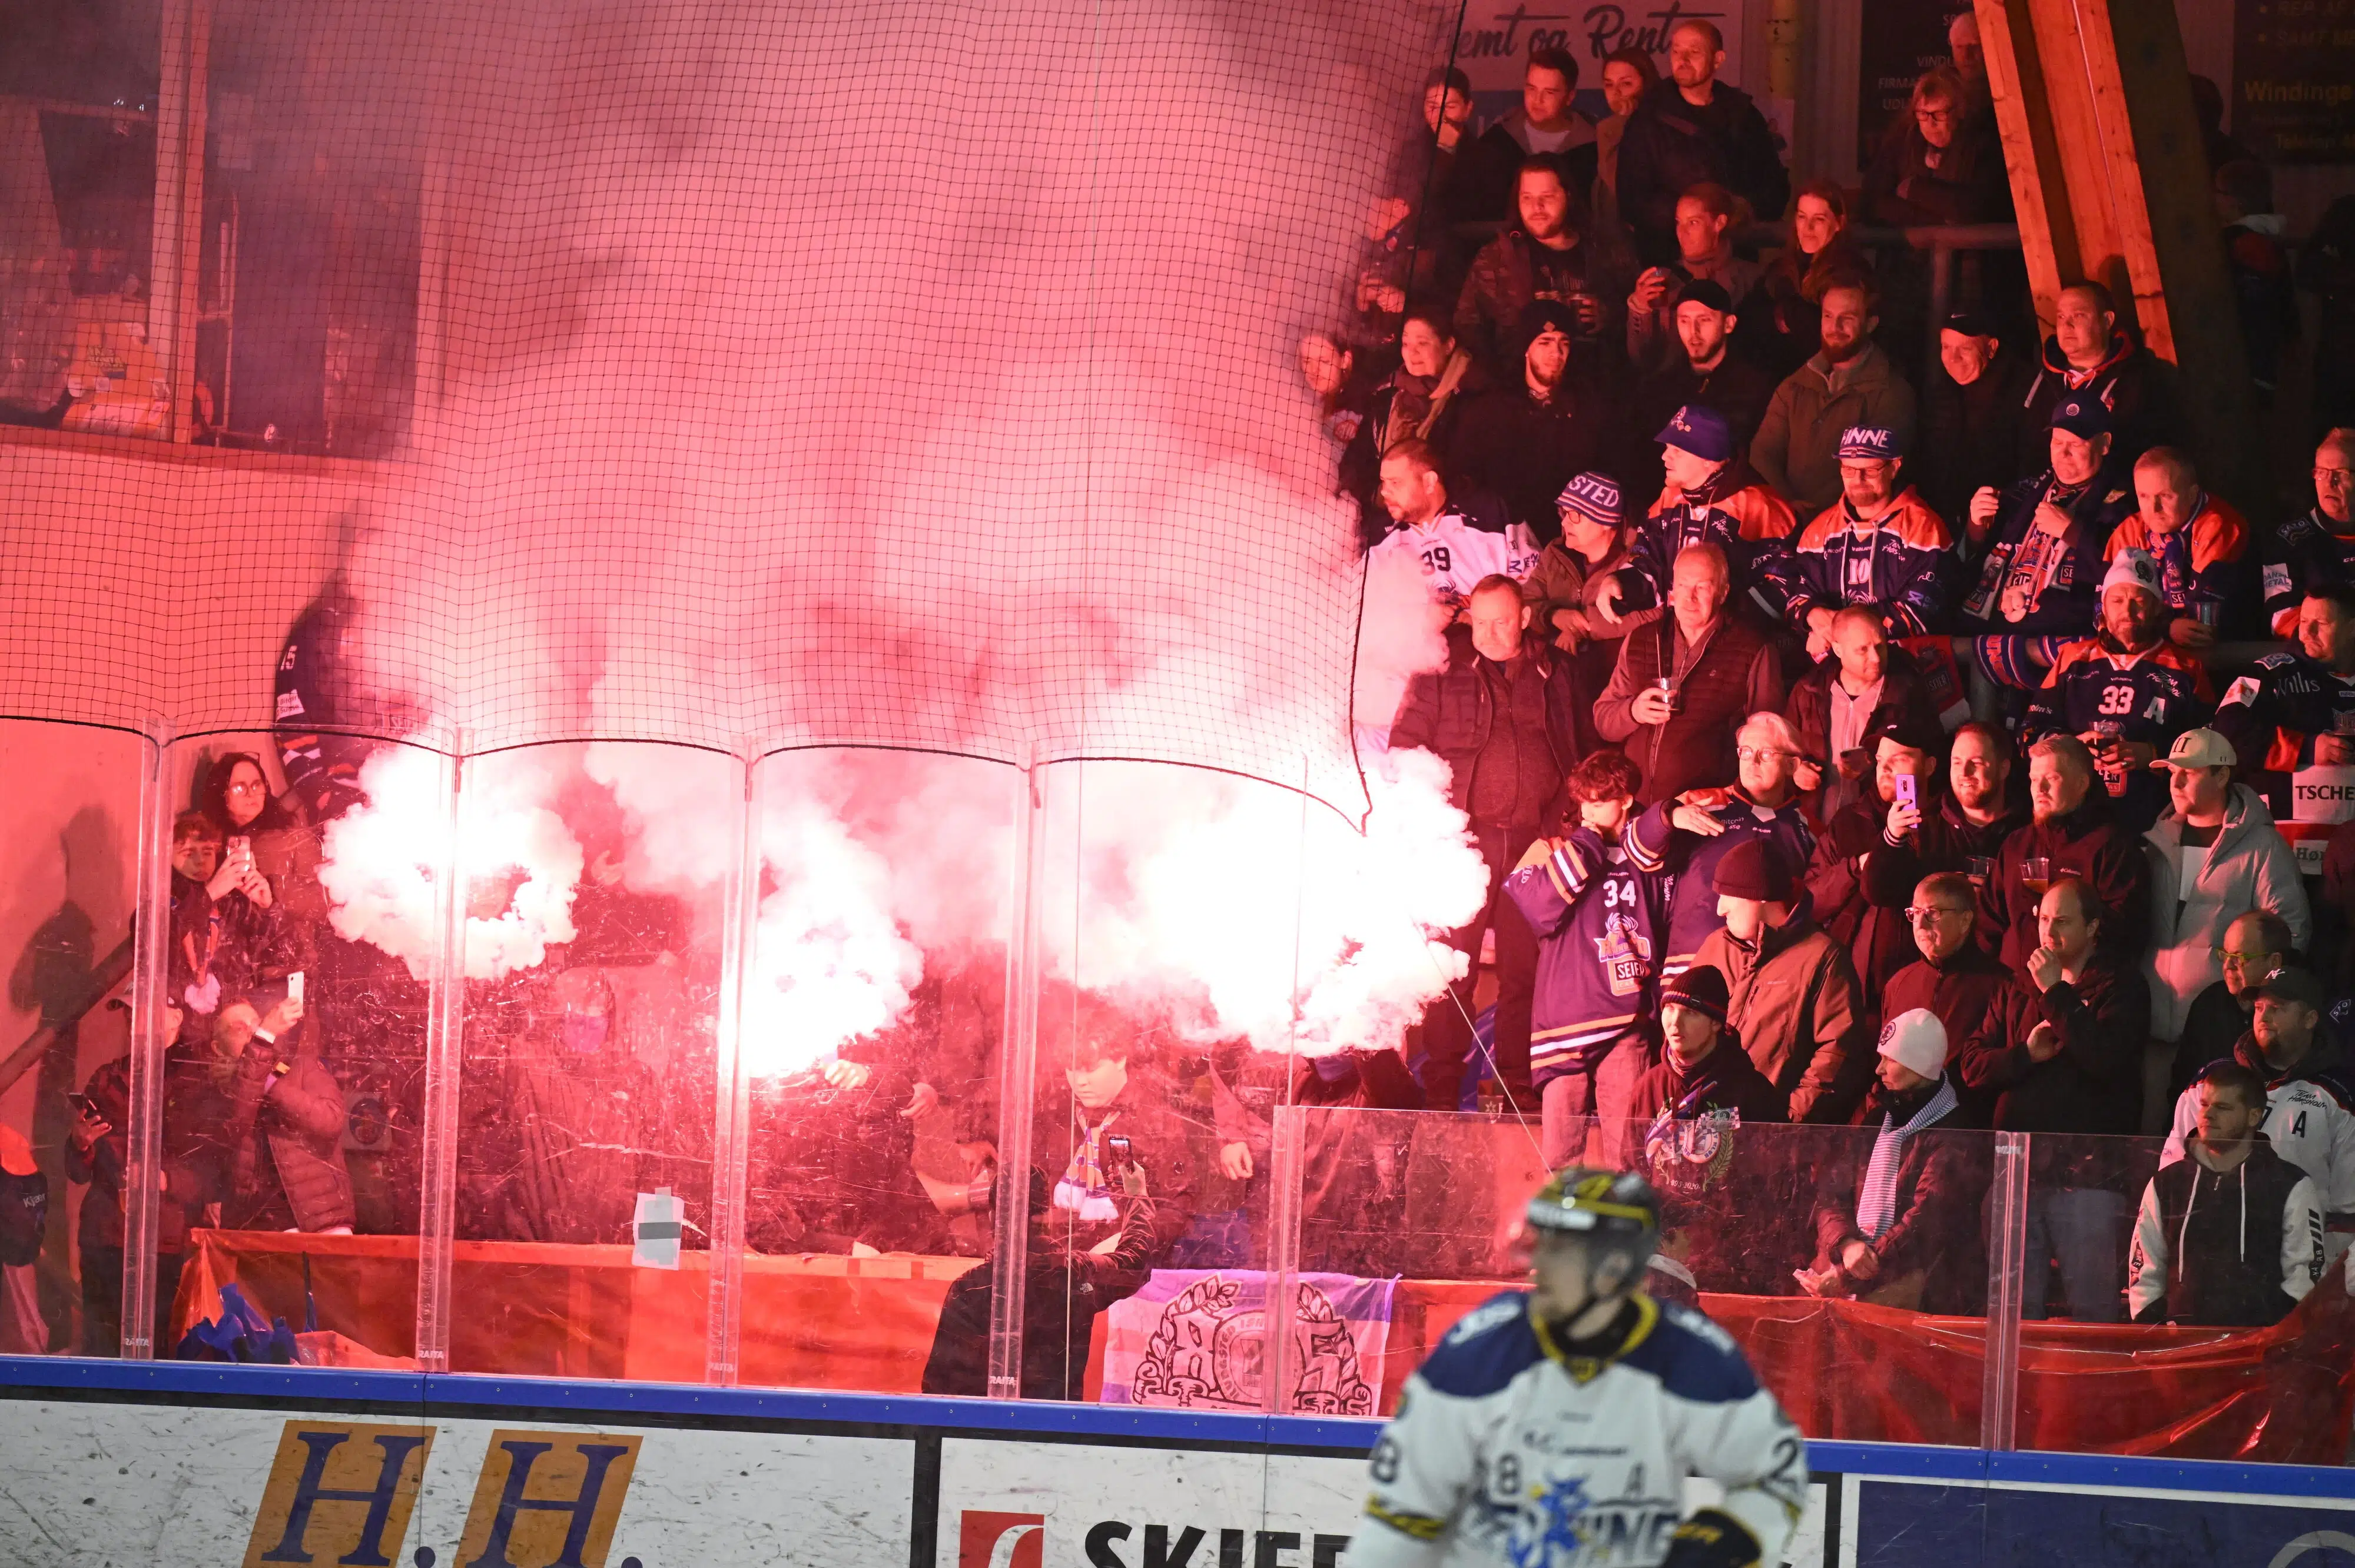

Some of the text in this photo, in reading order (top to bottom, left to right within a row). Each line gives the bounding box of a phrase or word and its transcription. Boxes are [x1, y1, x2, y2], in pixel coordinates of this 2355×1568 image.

[1457, 2, 1570, 59] emt
[1583, 1, 1727, 59] Rent
[1419, 547, 1451, 576] 39
[1848, 558, 1870, 585] 10
[2098, 685, 2135, 715] 33
[2143, 696, 2166, 725] A
[2295, 785, 2355, 800] TSCHE
[1603, 879, 1636, 907] 34
[2295, 1089, 2317, 1099] TEAM
[2291, 1110, 2307, 1138] A
